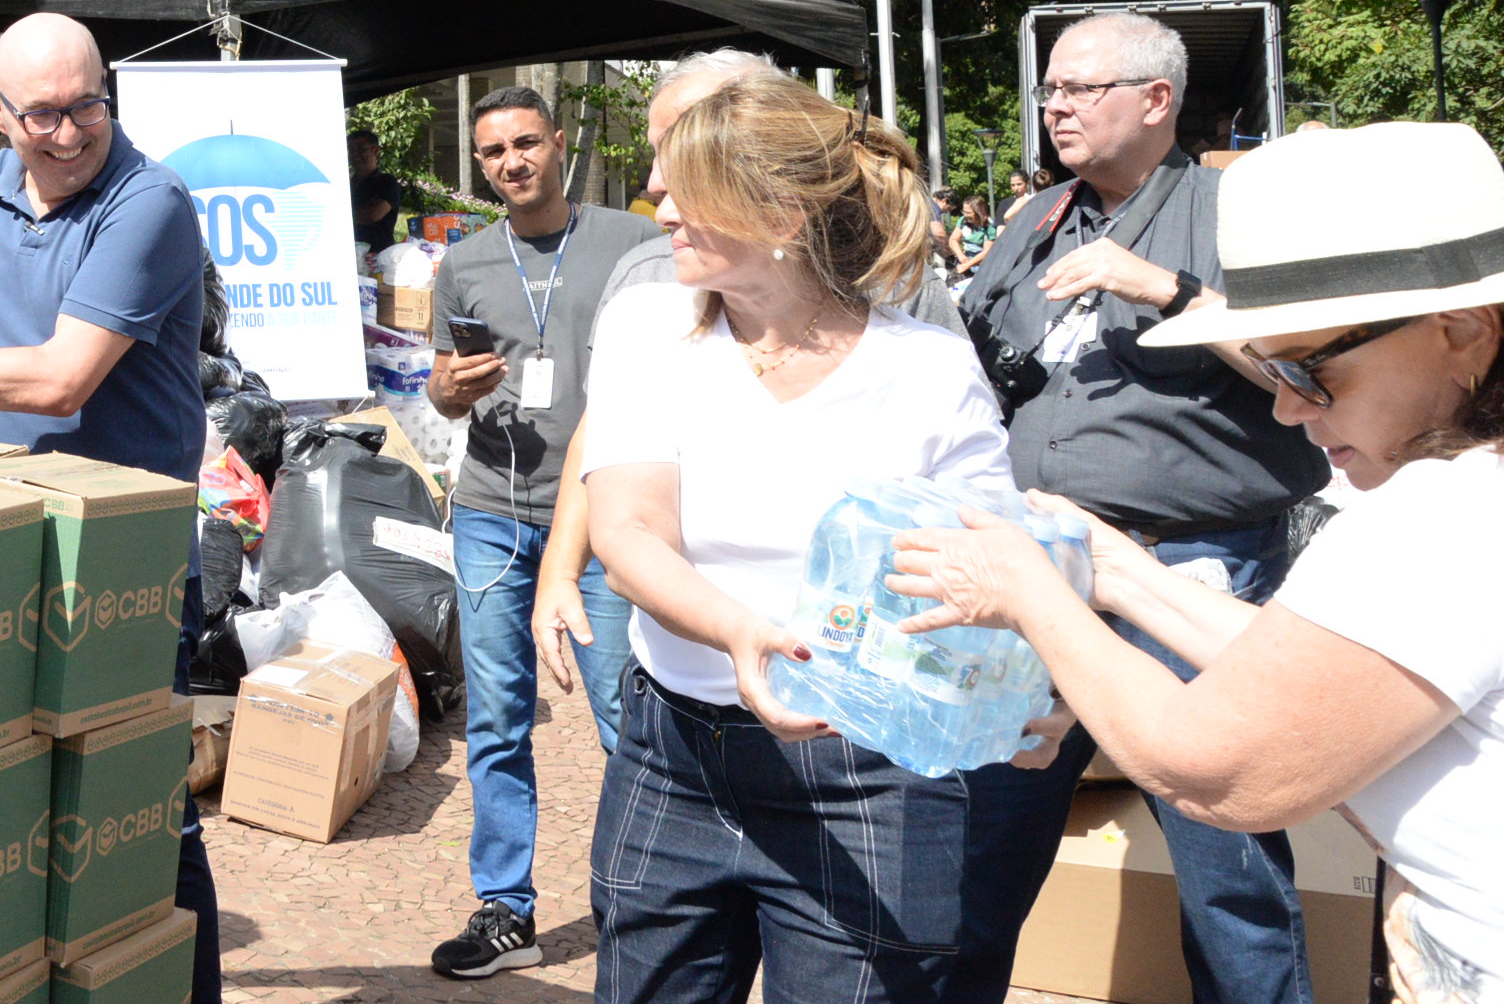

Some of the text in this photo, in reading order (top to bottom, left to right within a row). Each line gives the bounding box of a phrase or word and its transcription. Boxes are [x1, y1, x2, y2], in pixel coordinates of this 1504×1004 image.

[225, 281, 338, 309] NDE DO SUL
[44, 497, 65, 512] CBB
[118, 585, 162, 620] CBB
[120, 802, 163, 843] CBB
